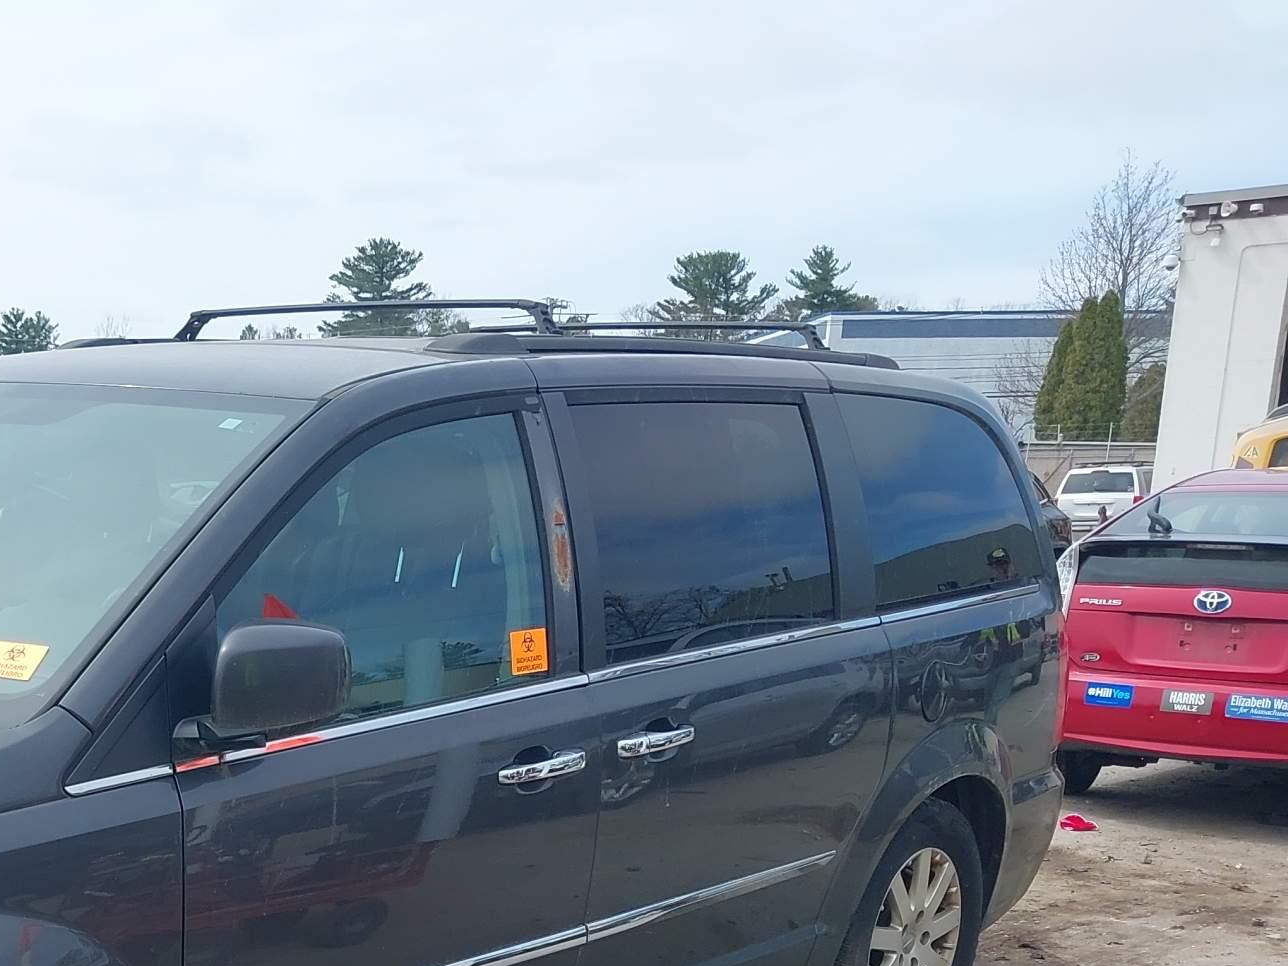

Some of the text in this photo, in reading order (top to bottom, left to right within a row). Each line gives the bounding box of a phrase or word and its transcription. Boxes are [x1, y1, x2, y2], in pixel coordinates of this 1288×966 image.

[1079, 597, 1123, 606] PRIUS
[1087, 687, 1131, 700] #HillYes
[1169, 691, 1206, 706] HARRIS
[1173, 704, 1199, 712] WALZ
[1230, 695, 1288, 711] Elizabeth Wa
